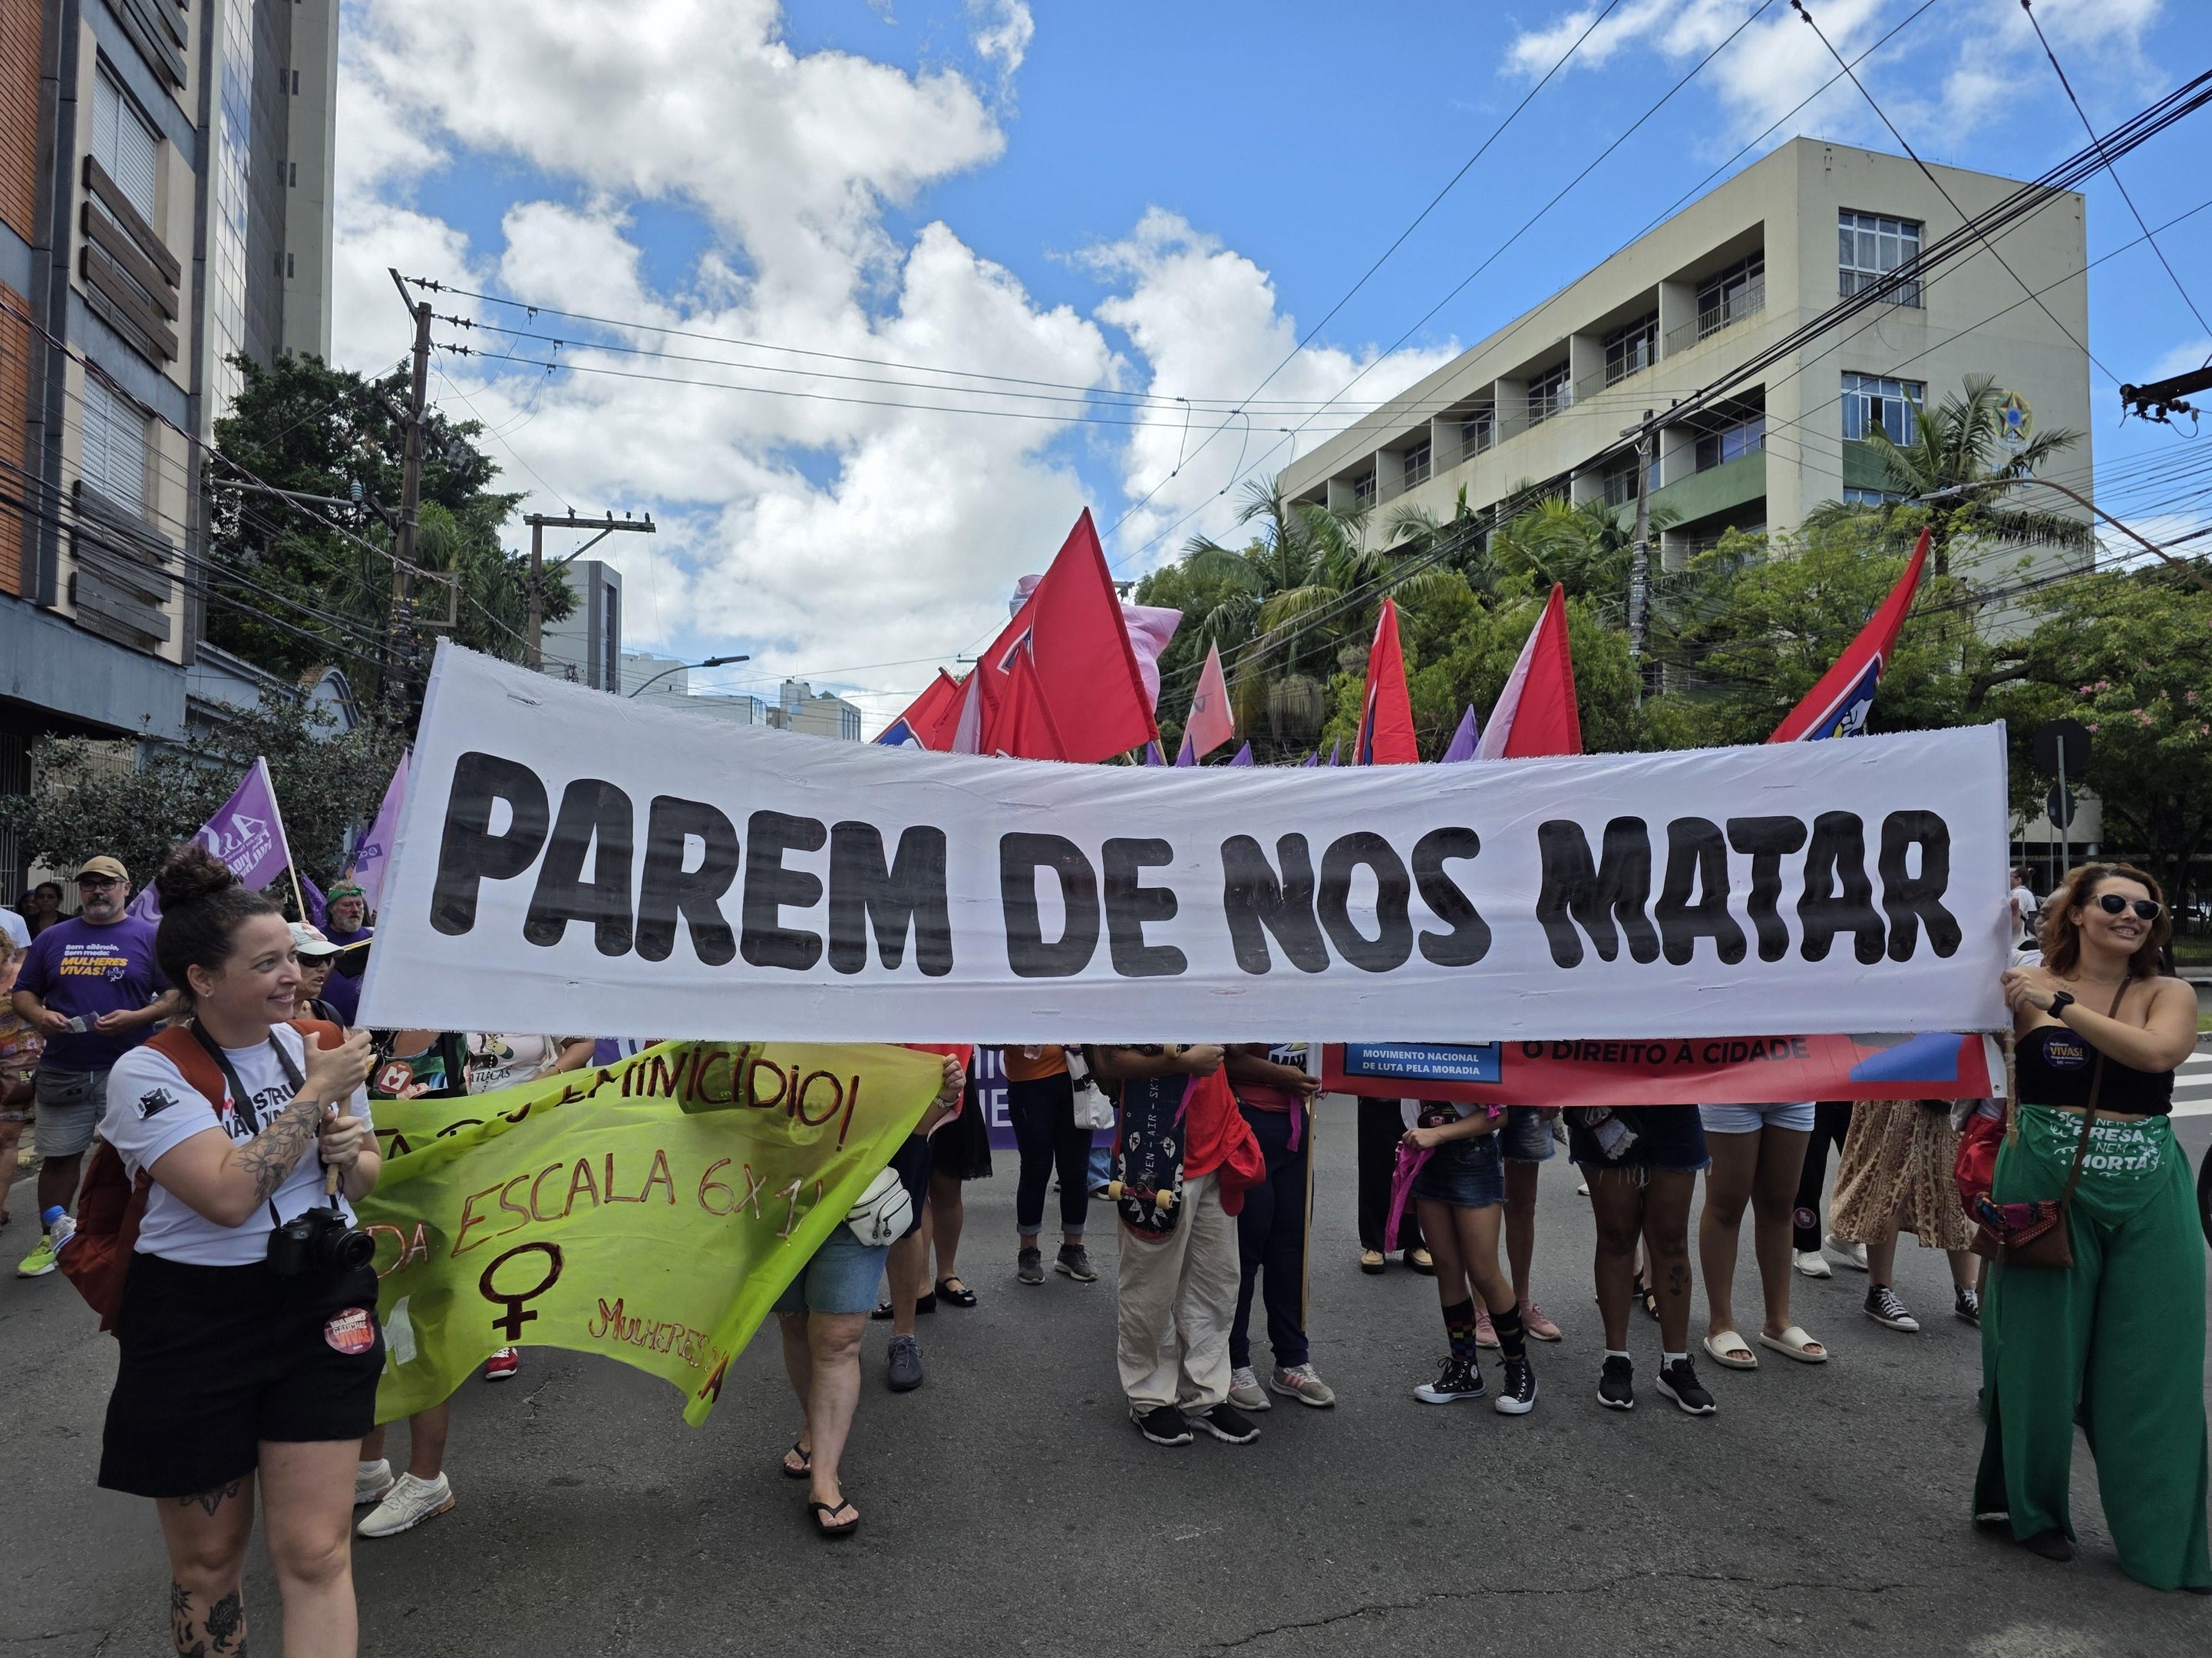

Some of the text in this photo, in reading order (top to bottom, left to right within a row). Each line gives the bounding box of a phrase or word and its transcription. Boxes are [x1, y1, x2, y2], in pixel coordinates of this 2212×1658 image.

[430, 751, 1962, 977] PAREM DE NOS MATAR
[61, 957, 128, 966] MULHERES
[60, 966, 106, 976] VIVAS!
[1363, 1049, 1479, 1062] MOVIMENTO NACIONAL
[1522, 1042, 1543, 1059] O
[1552, 1041, 1666, 1065] DIREITO
[1702, 1038, 1810, 1064] CIDADE
[2050, 1047, 2083, 1056] VIVAS!
[1362, 1062, 1480, 1075] DE LUTA PELA MORADIA
[1147, 1114, 1157, 1137] AIR
[2095, 1118, 2127, 1127] NEM
[2095, 1142, 2128, 1154] NEM
[451, 1149, 675, 1257] ESCALA
[589, 1298, 711, 1368] MULHERES
